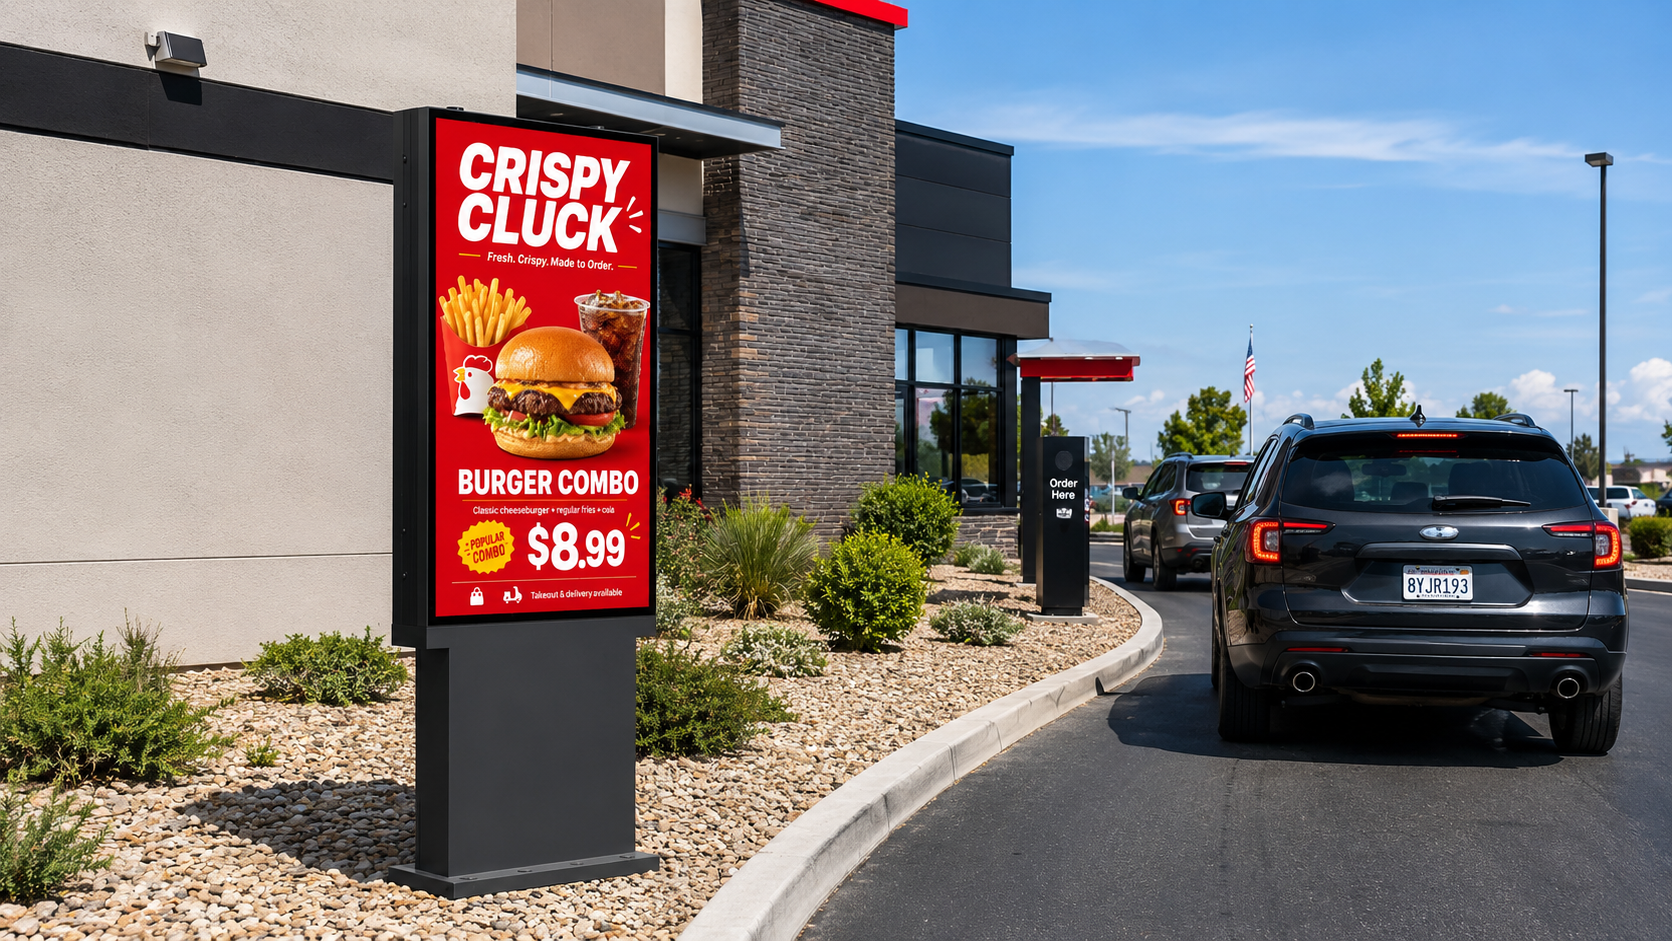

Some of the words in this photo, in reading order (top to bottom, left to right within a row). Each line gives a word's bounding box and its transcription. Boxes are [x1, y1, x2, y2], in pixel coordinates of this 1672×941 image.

[459, 142, 631, 203] CRISPY
[458, 192, 623, 253] CLUCK
[487, 251, 516, 264] Fresh.
[517, 253, 549, 268] Crispy.
[550, 256, 575, 268] Made
[576, 259, 586, 269] to
[587, 259, 614, 271] Order.
[458, 469, 552, 495] BURGER
[557, 469, 639, 495] COMBO
[1049, 478, 1078, 488] Order
[1051, 490, 1076, 500] Here
[472, 506, 499, 515] Classic
[499, 506, 549, 516] cheeseburger
[556, 505, 580, 516] regular
[581, 505, 596, 514] fries
[470, 531, 505, 550] POPULAR
[527, 521, 626, 571] $8.99
[473, 543, 506, 564] COMBO
[530, 590, 559, 600] Takeout
[559, 590, 565, 598] &
[565, 589, 593, 599] delivery
[593, 587, 623, 597] available
[1407, 577, 1469, 594] 8YJR193
